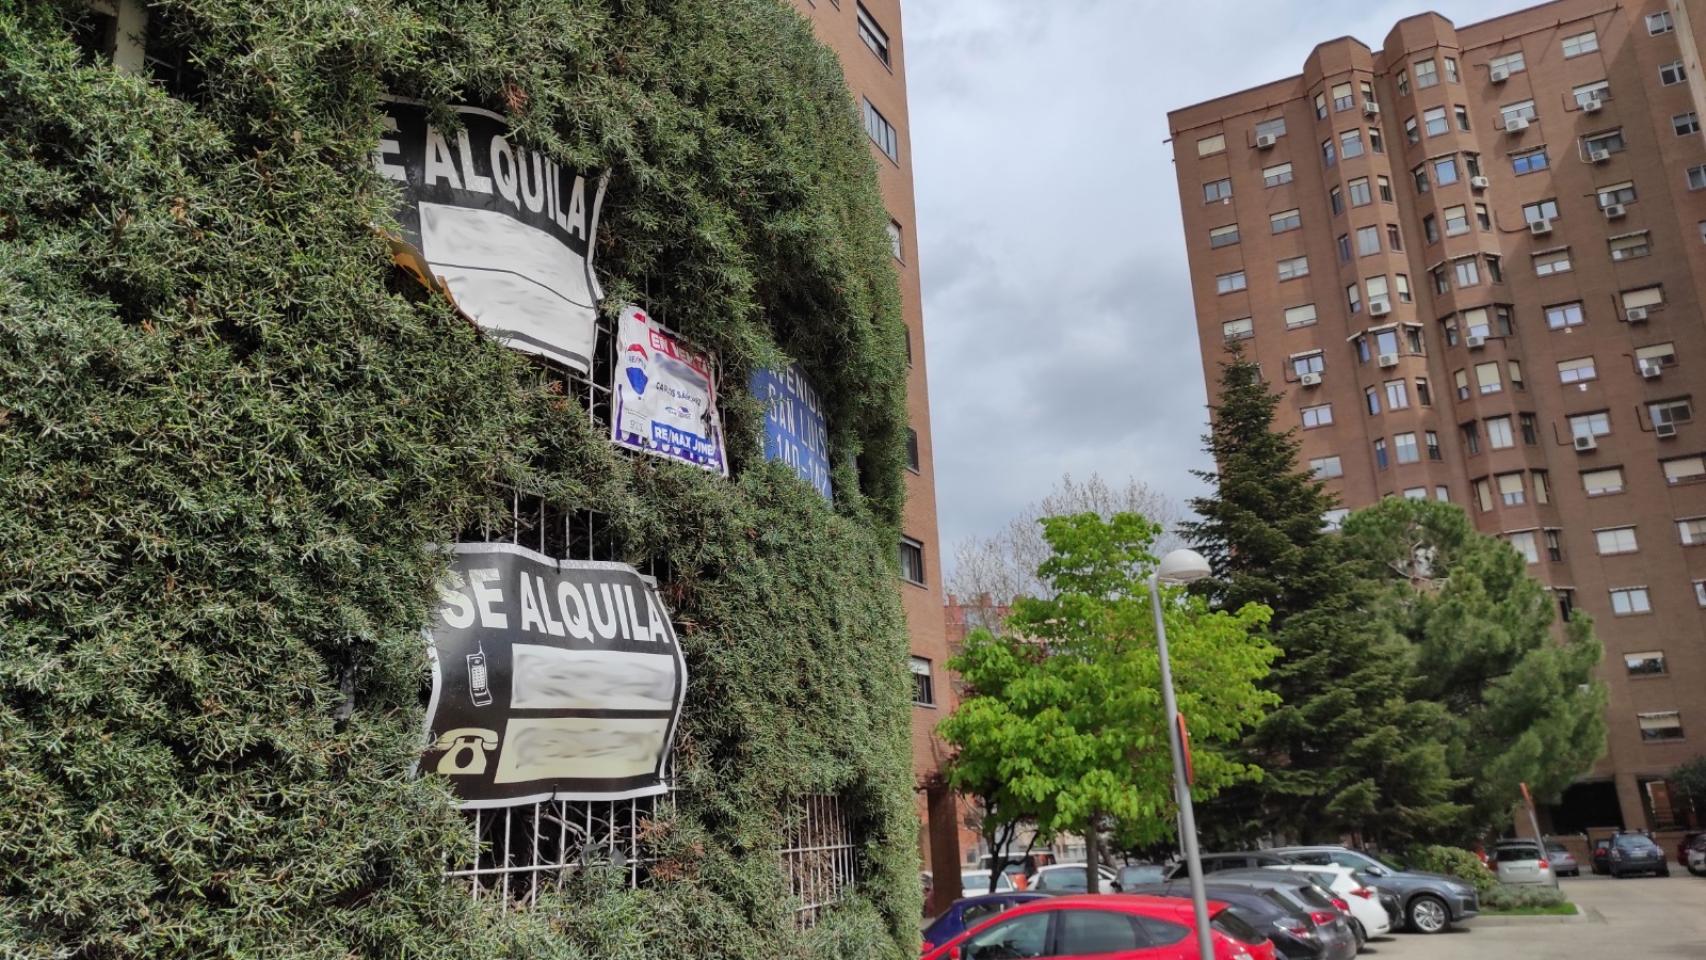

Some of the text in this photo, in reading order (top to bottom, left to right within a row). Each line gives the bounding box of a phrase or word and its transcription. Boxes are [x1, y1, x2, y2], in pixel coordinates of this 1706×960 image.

[424, 124, 587, 242] ALQUILA
[654, 425, 691, 449] RE/MAX
[768, 383, 828, 462] SAN LUIS
[437, 567, 670, 644] SE ALQUILA
